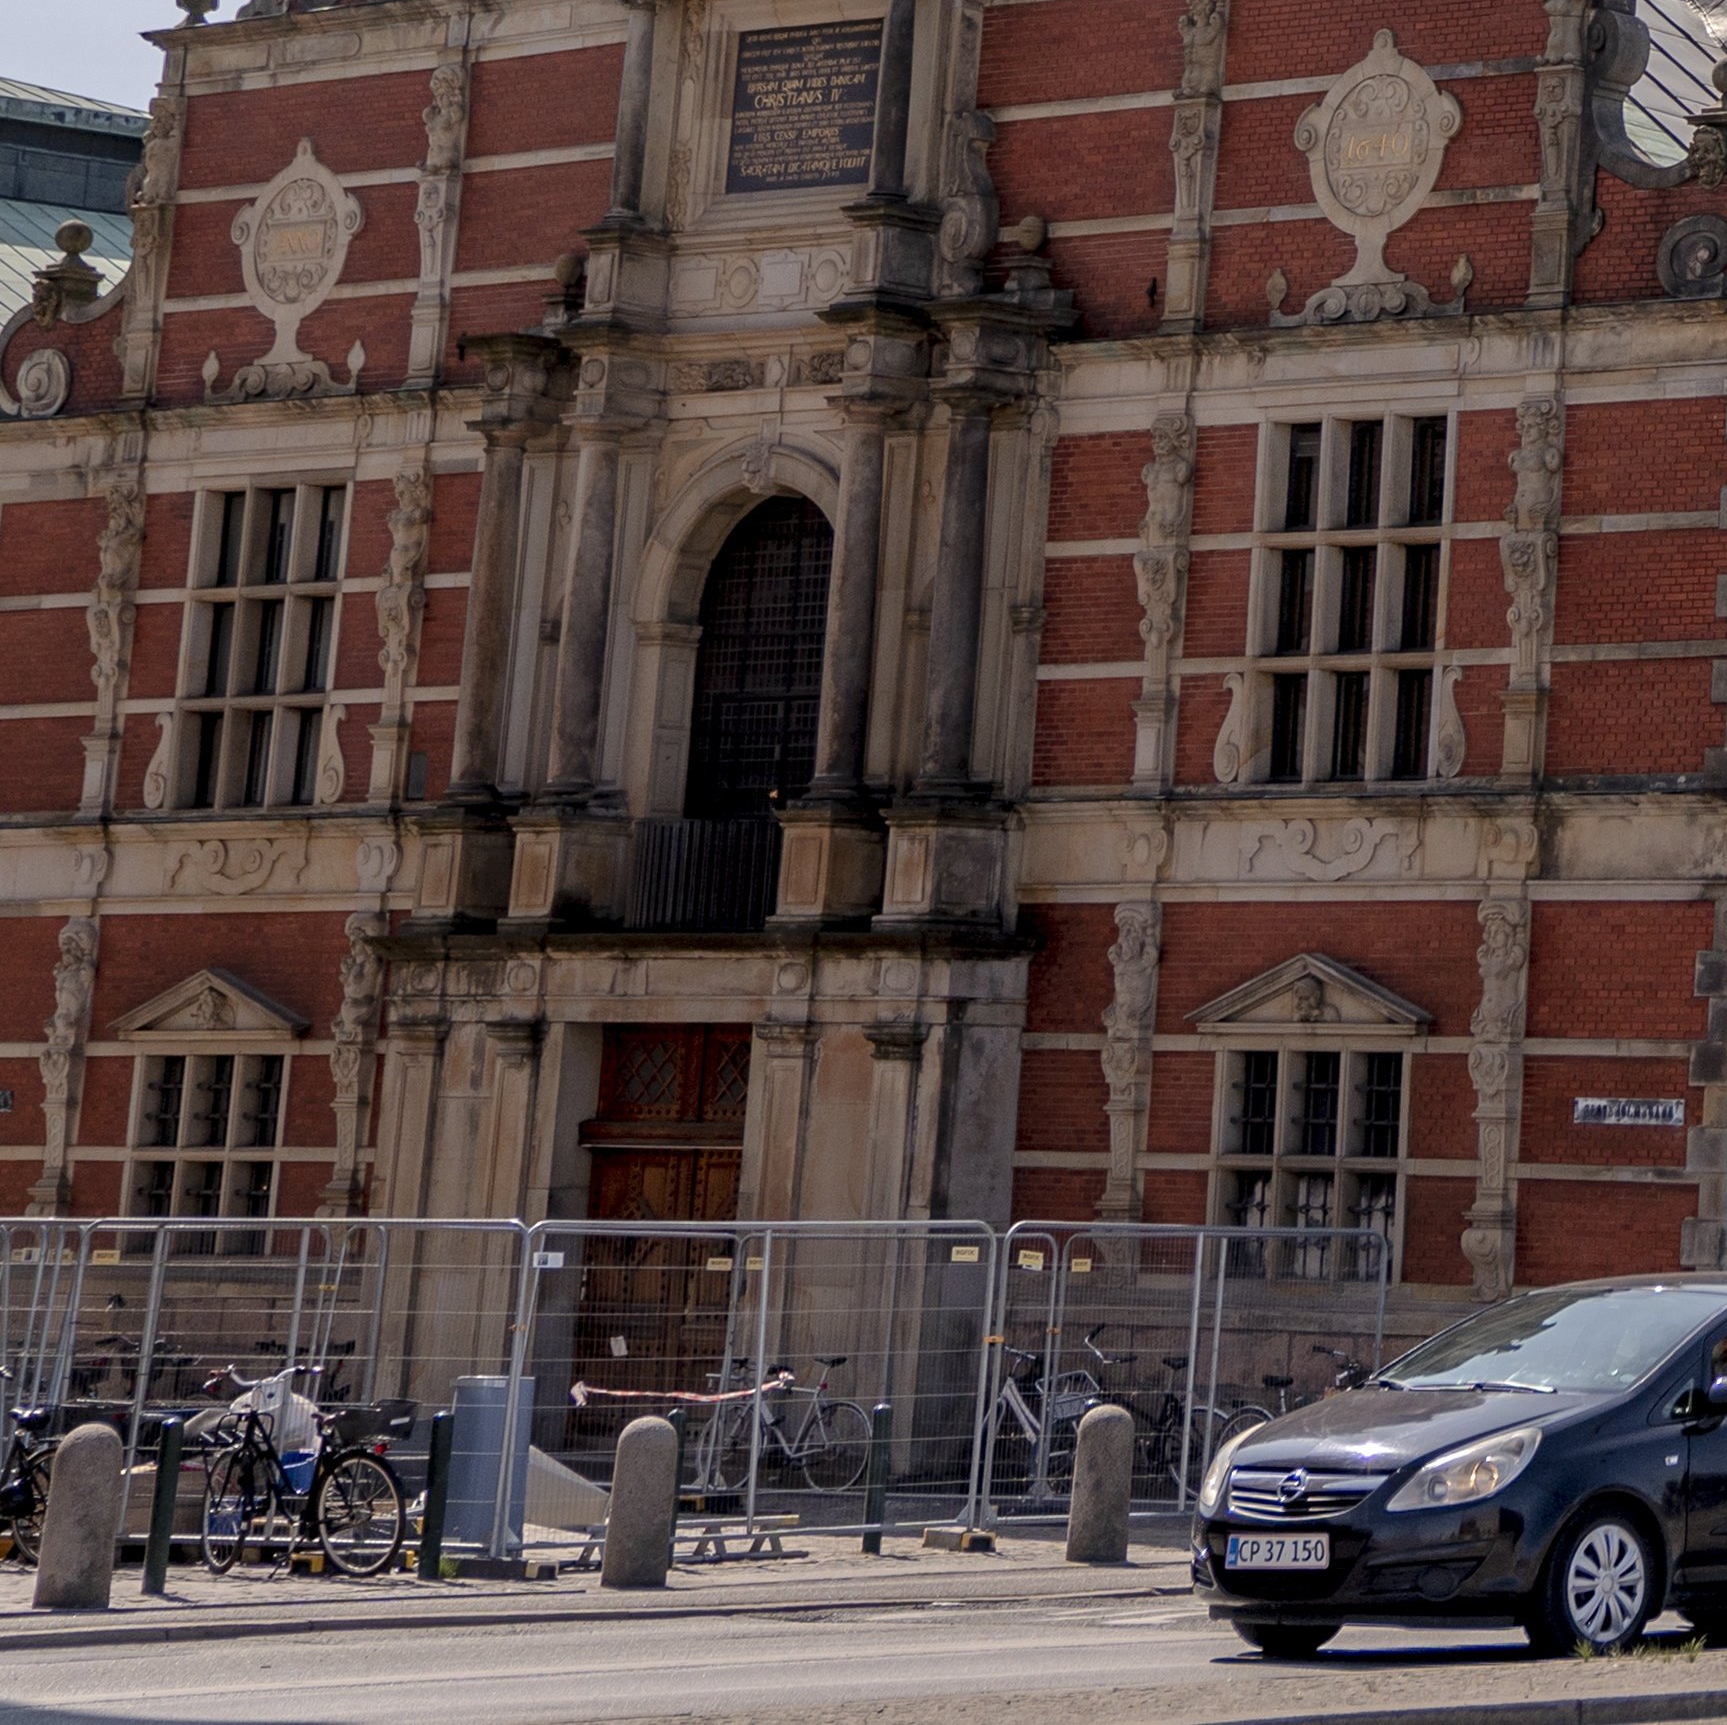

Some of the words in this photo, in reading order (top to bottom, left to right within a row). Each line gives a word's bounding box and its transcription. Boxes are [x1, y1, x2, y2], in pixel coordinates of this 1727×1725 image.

[1240, 1540, 1261, 1562] CP
[1264, 1540, 1285, 1562] 37
[1291, 1540, 1325, 1562] 150
